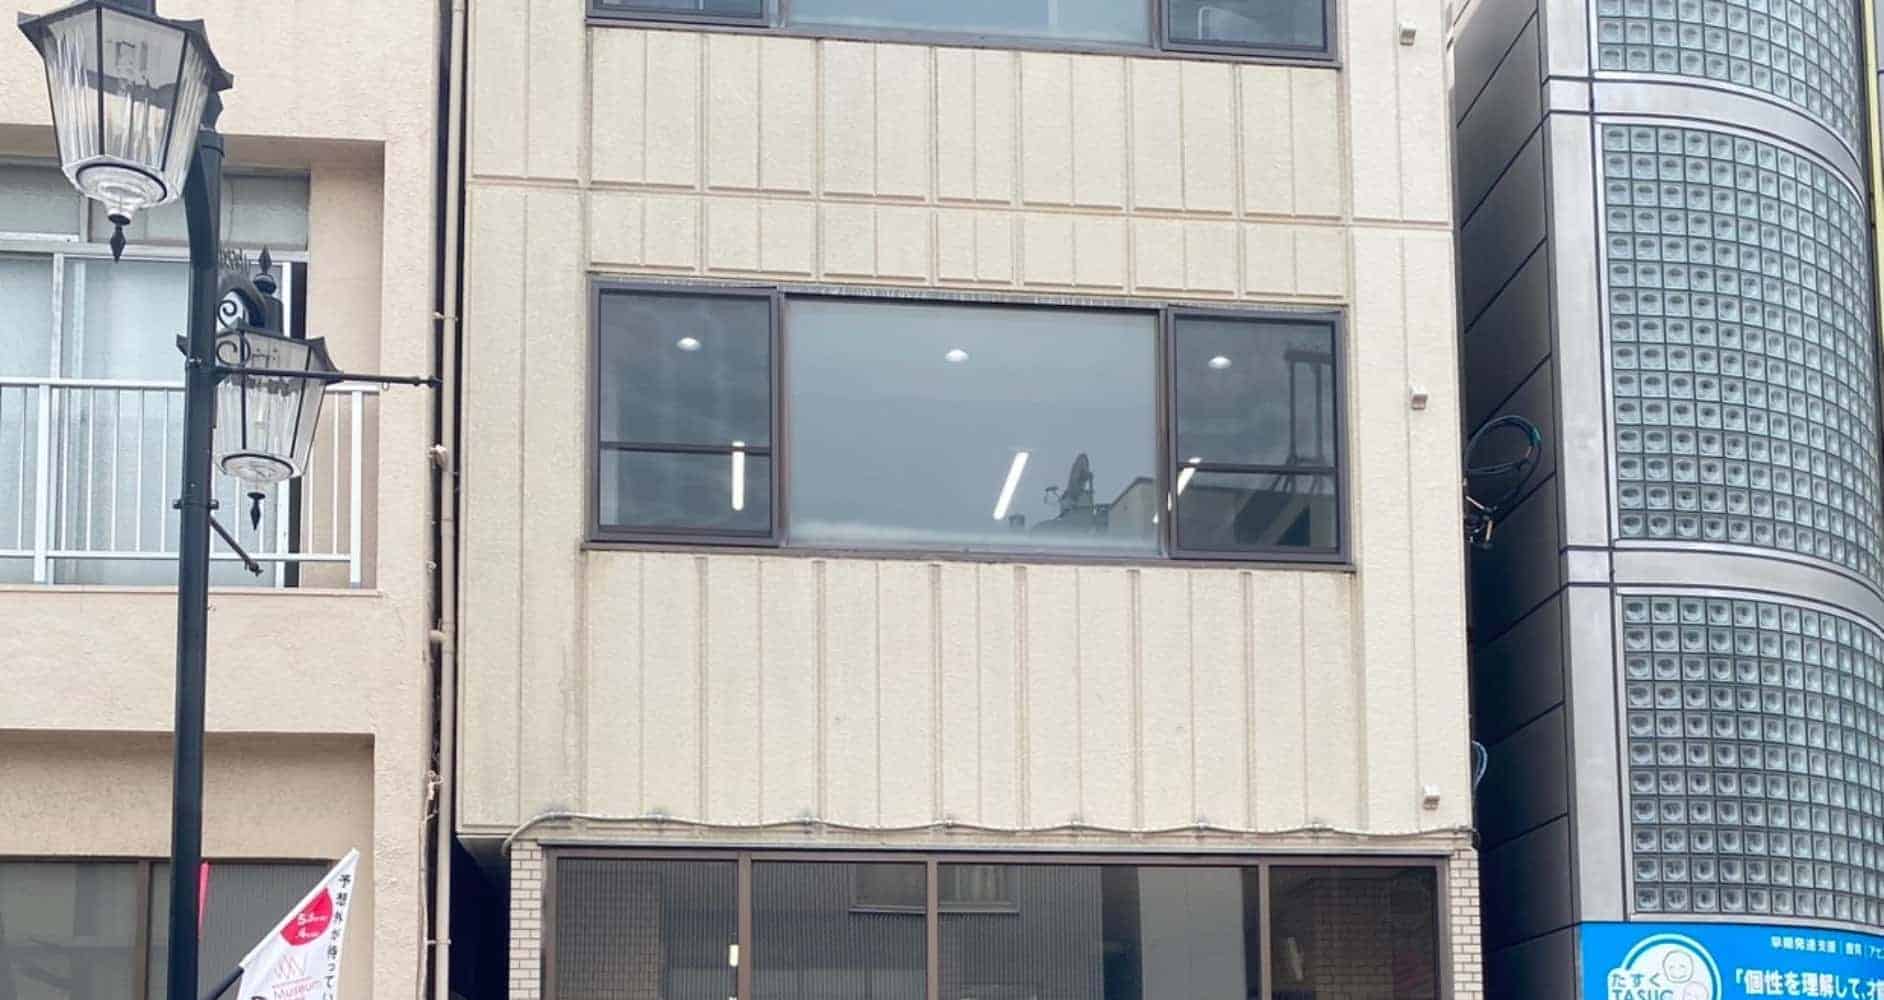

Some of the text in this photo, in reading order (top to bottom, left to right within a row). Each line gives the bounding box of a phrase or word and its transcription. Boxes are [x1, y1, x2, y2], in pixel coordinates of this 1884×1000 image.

[1611, 972, 1662, 988] たすく
[274, 980, 321, 1000] Museum
